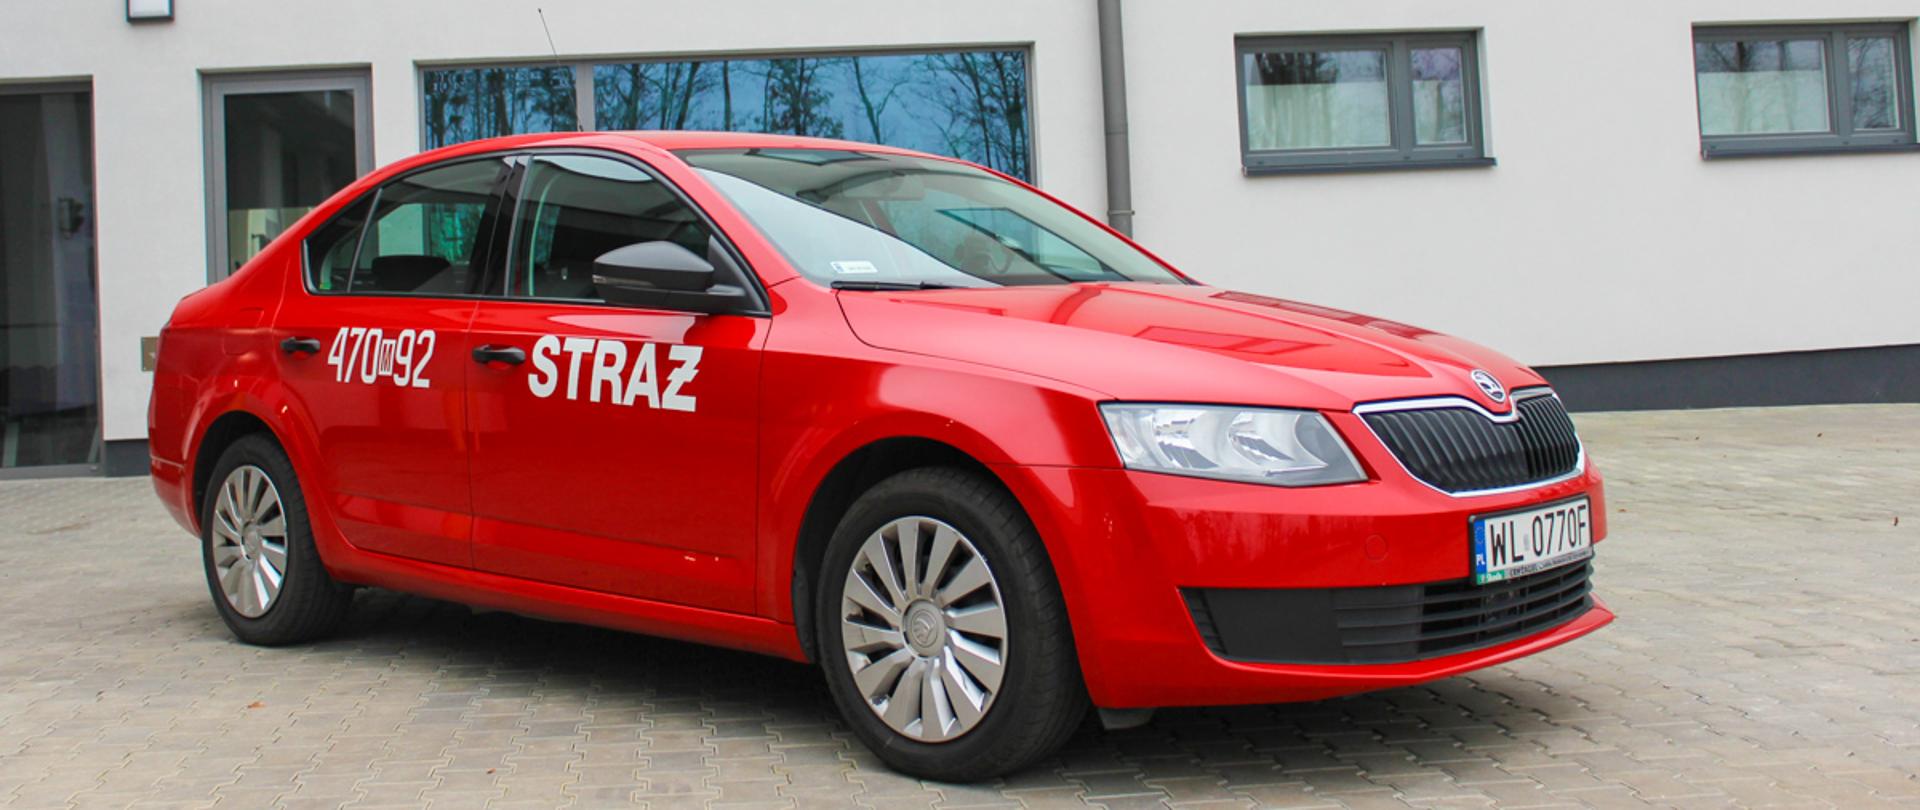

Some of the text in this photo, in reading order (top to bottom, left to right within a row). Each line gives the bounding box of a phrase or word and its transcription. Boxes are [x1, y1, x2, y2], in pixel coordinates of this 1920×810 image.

[1490, 520, 1524, 566] WL
[1532, 505, 1586, 556] 0770F
[1475, 554, 1486, 566] PL
